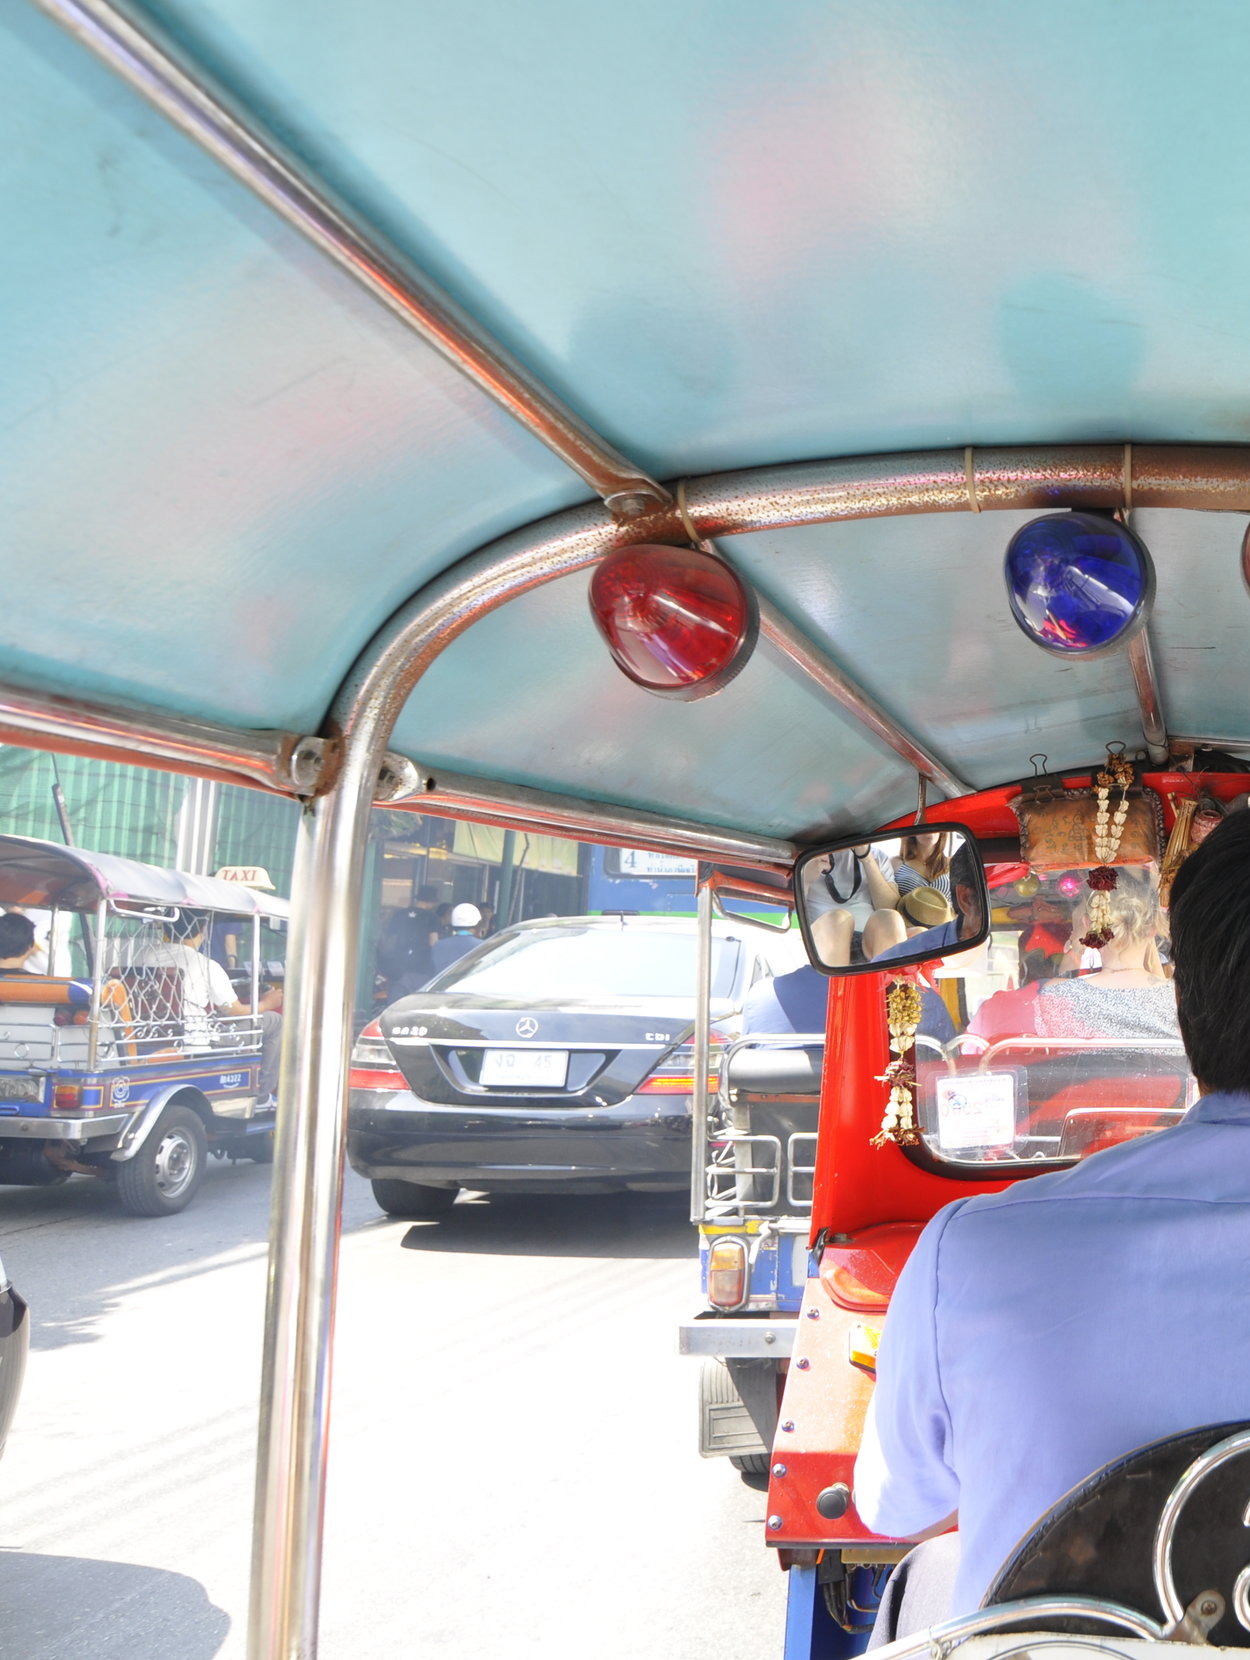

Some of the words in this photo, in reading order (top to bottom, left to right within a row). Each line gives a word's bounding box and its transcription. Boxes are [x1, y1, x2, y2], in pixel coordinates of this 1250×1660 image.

[624, 850, 637, 868] 4
[222, 869, 257, 881] TAXI
[645, 1032, 670, 1042] CDI
